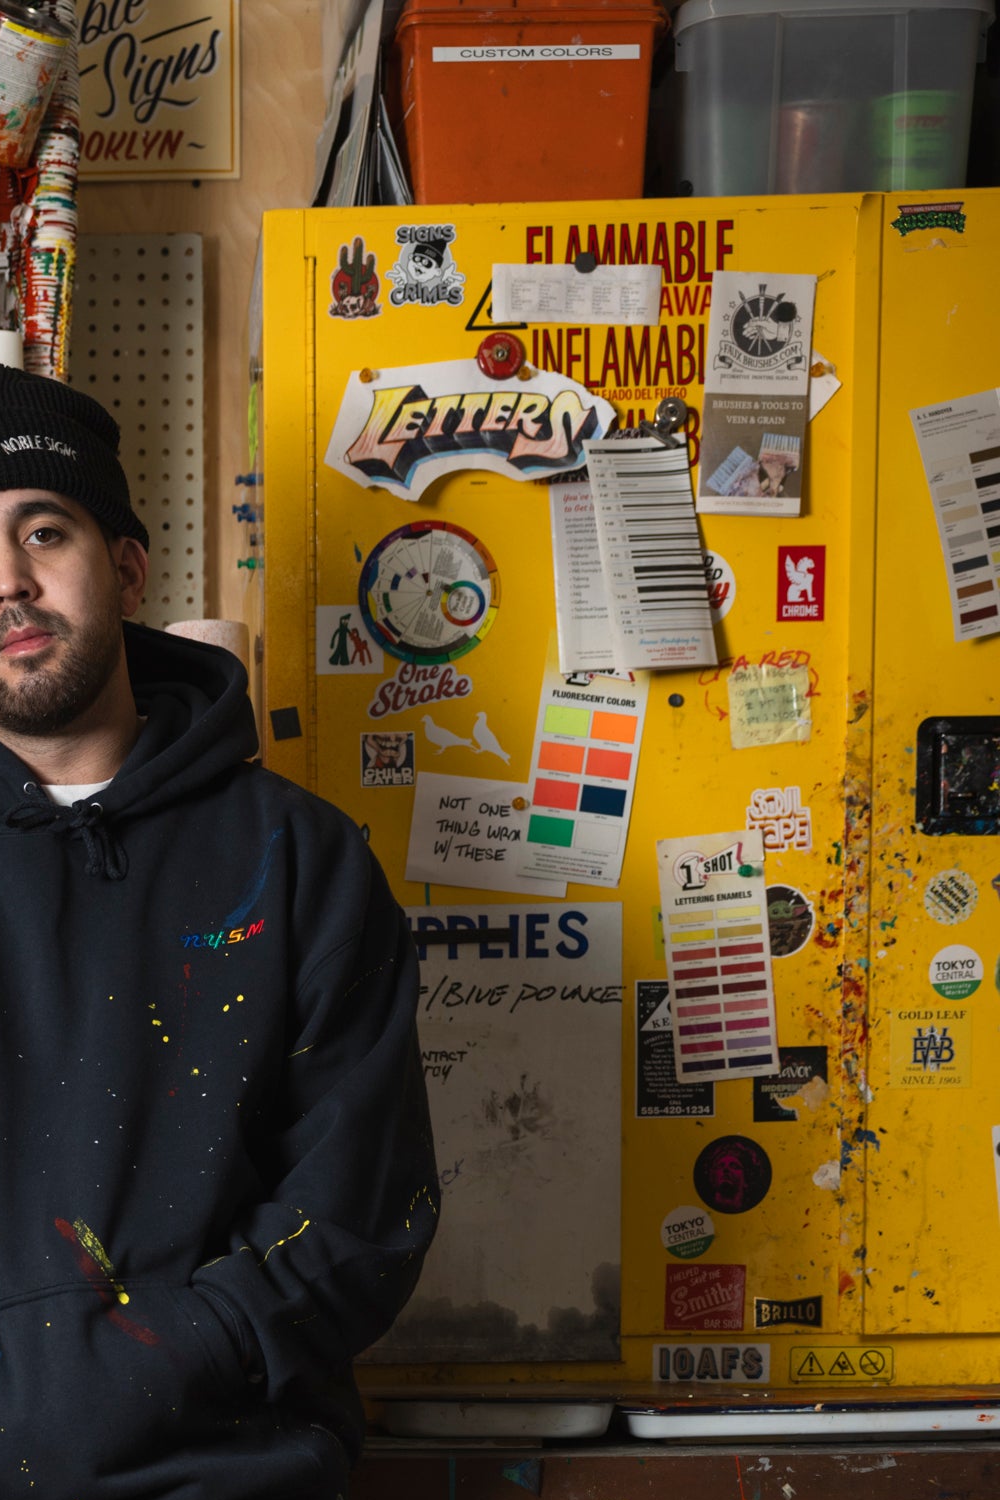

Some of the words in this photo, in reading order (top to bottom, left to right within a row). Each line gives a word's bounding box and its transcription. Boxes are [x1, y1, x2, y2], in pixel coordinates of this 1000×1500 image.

[460, 47, 535, 58] CUSTOM
[540, 46, 613, 57] COLORS
[96, 29, 222, 124] Signs
[79, 130, 184, 162] OKLYN
[397, 226, 454, 243] SIGNS
[390, 285, 463, 305] CRIMES
[660, 284, 712, 316] AWA
[533, 323, 705, 388] INFLAMABL
[634, 388, 652, 400] DEL
[655, 387, 687, 399] FUEGO
[712, 401, 752, 409] BRUSHES
[792, 402, 803, 410] TO
[726, 416, 748, 424] VEIN
[757, 416, 786, 424] GRAIN
[345, 384, 597, 482] LETTERS
[0, 434, 41, 455] NOBLE
[782, 604, 819, 617] CHROME
[759, 650, 811, 669] RED
[399, 664, 439, 685] One
[369, 667, 470, 718] Stroke
[552, 689, 605, 704] FLUORESCENT
[606, 696, 636, 708] COLORS
[363, 772, 413, 785] EATER
[364, 767, 412, 779] CHILD
[439, 796, 471, 811] NOT
[478, 802, 511, 817] ONE
[436, 819, 481, 837] THING
[434, 836, 453, 862] W/
[454, 844, 507, 861] THESE
[681, 856, 706, 891] 1
[704, 851, 734, 873] SHOT
[675, 894, 715, 906] LETTERING
[716, 890, 752, 902] ENAMELS
[409, 911, 589, 961] PPLIES
[936, 959, 975, 971] TOKYO
[935, 971, 975, 981] CENTRAL
[941, 983, 972, 991] Specialty
[898, 1011, 934, 1021] GOLD
[938, 1010, 967, 1020] LEAF
[422, 1050, 468, 1063] NTACT
[901, 1076, 934, 1085] SINCE
[641, 1106, 710, 1115] 555-420-1234
[665, 1217, 705, 1235] TOKYO
[667, 1228, 706, 1244] CENTRAL
[673, 1267, 700, 1281] HELPED
[709, 1269, 721, 1280] THE
[671, 1282, 741, 1317] Smith's
[761, 1301, 816, 1321] BRILLO
[704, 1319, 721, 1328] BAR
[722, 1319, 742, 1328] SIGN
